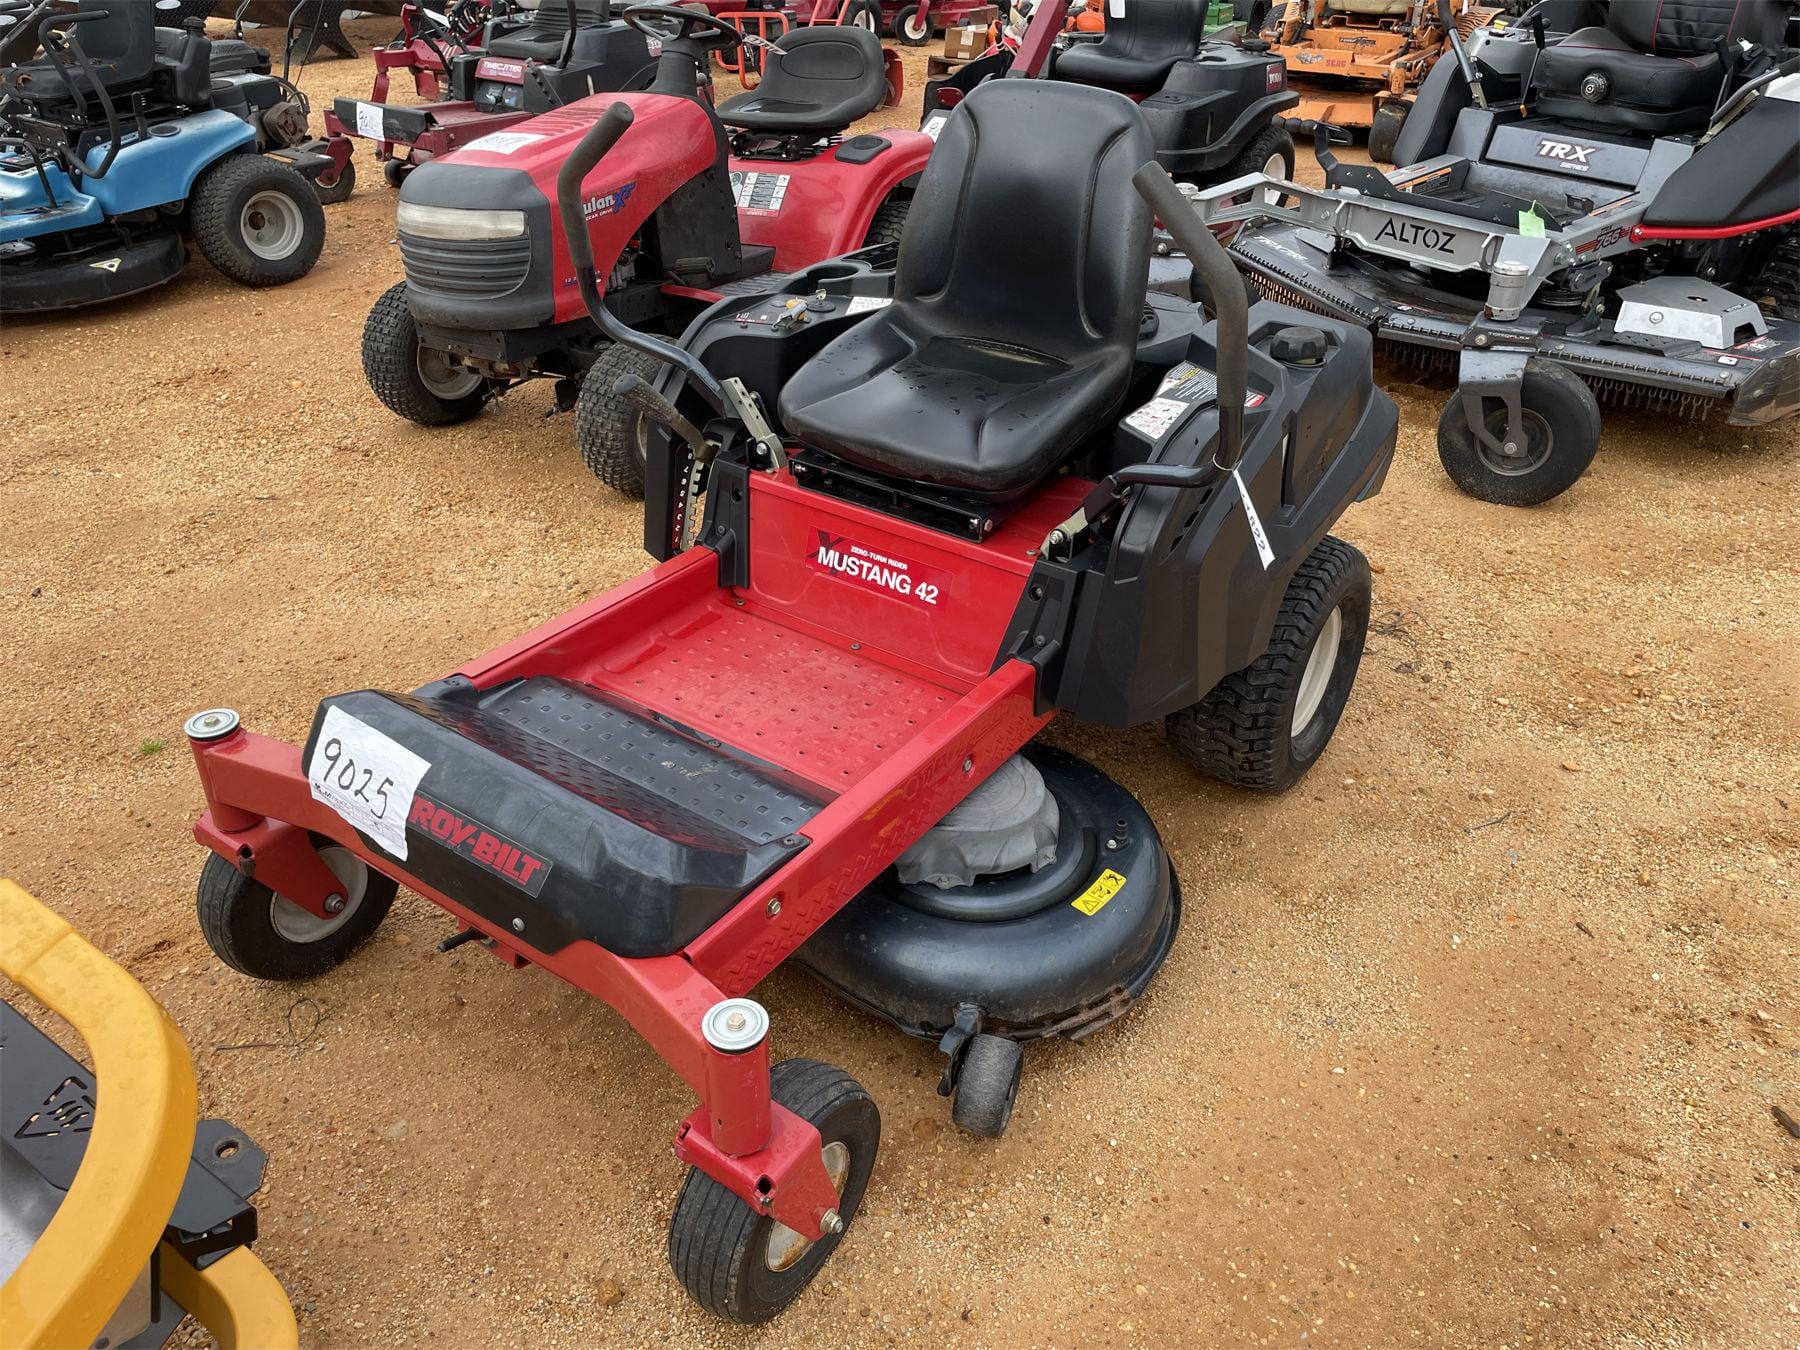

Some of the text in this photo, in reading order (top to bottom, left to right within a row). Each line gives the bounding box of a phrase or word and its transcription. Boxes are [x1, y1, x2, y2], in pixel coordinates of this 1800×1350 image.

[1326, 59, 1346, 68] SCAG
[1539, 140, 1597, 163] TRX
[1560, 161, 1589, 172] SERIES
[583, 195, 615, 215] ulan
[1374, 217, 1457, 254] ALTOZ
[1592, 226, 1623, 253] 766
[850, 545, 908, 571] ZERO-TURN RIDER
[817, 546, 939, 605] MUSTANG 42
[324, 737, 394, 819] 9025
[409, 794, 542, 886] ROY-BILT
